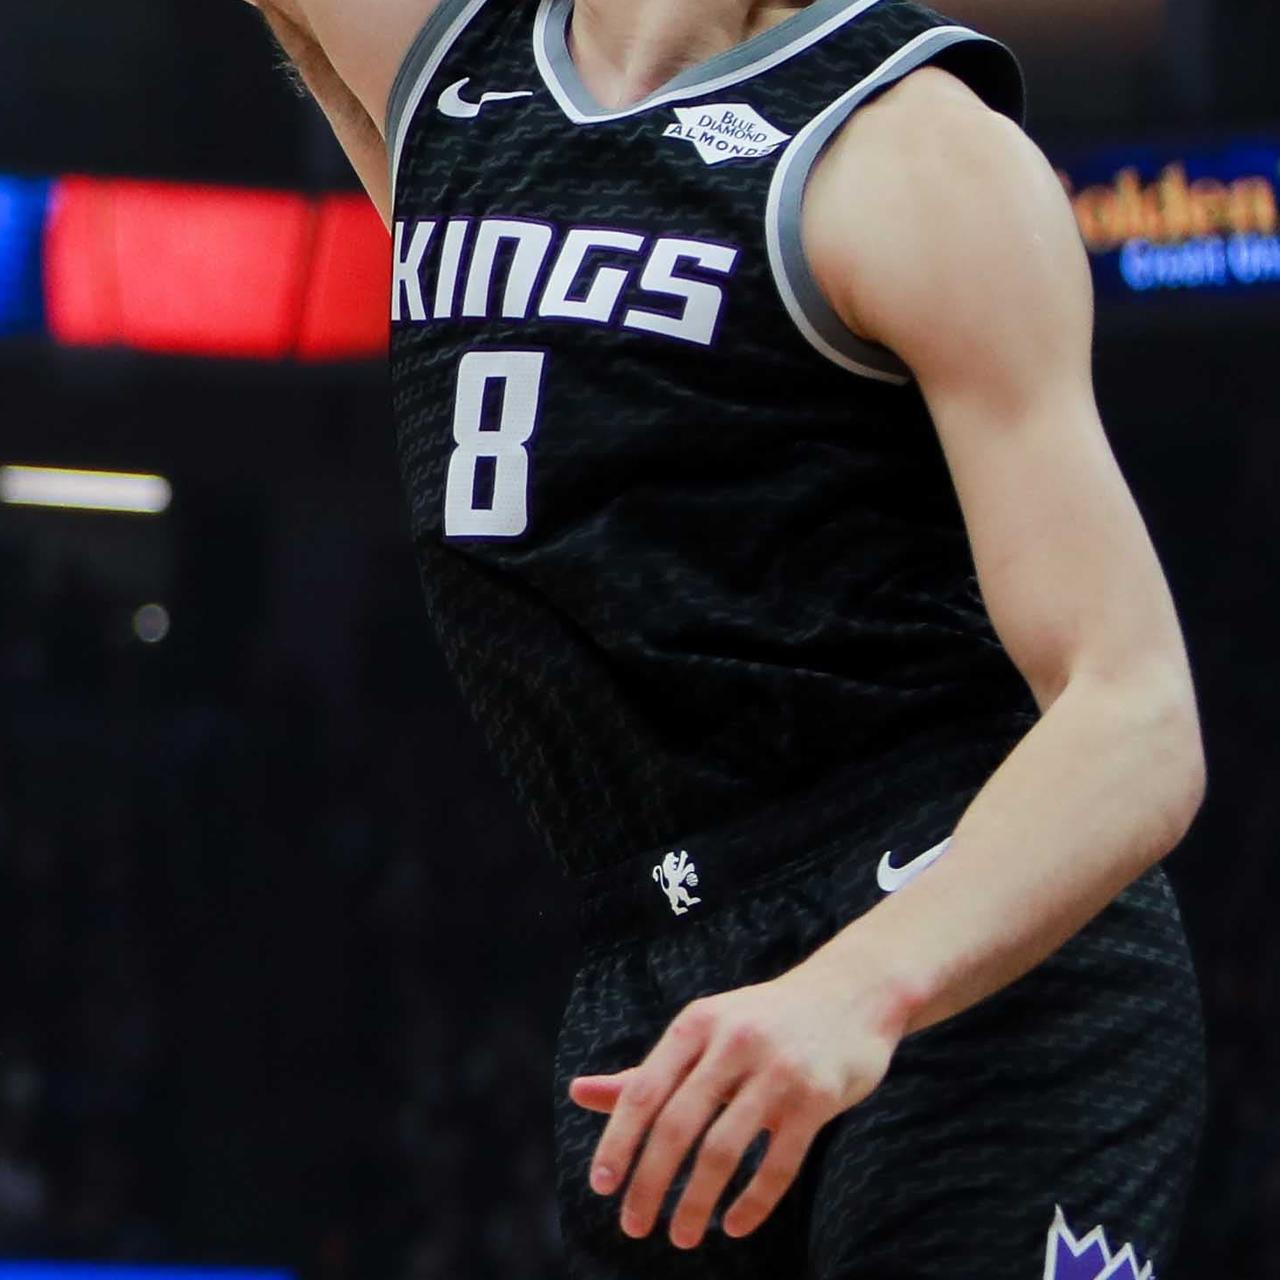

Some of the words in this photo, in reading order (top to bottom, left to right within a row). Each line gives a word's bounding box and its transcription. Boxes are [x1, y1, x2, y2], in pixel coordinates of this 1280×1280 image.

[698, 115, 768, 144] DIAMOND
[391, 217, 739, 346] KINGS
[444, 349, 546, 538] 8
